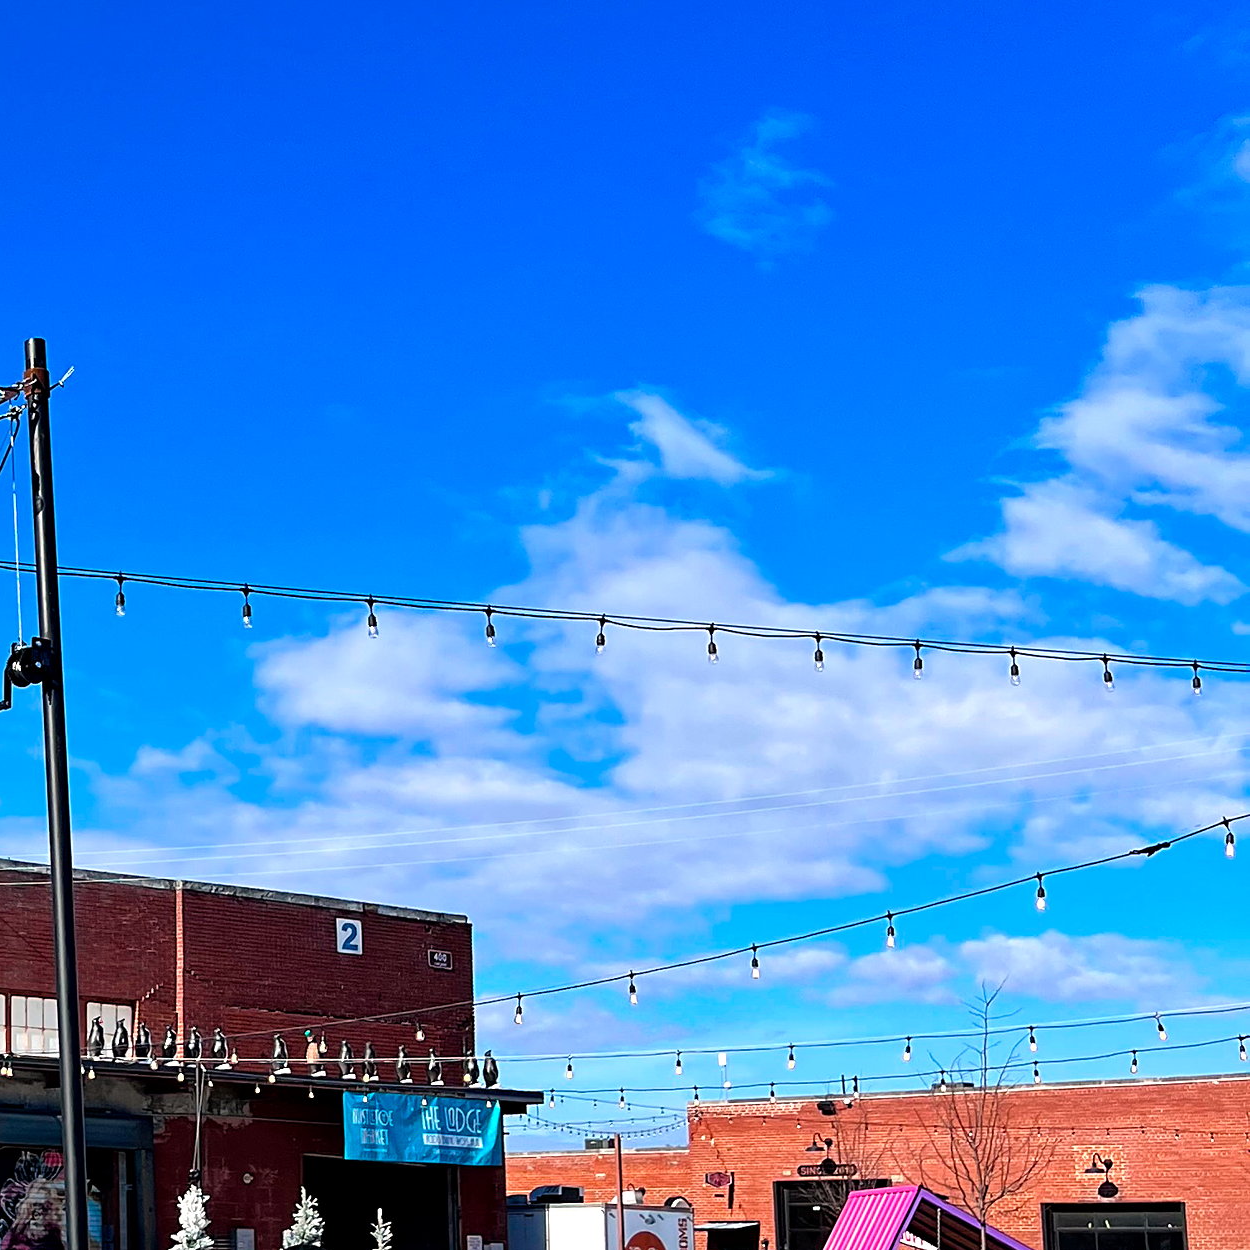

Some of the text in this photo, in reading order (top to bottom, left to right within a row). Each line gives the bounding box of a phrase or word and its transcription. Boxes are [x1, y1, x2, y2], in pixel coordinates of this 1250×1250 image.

[341, 922, 359, 951] 2
[421, 1105, 482, 1134] THE LODGE
